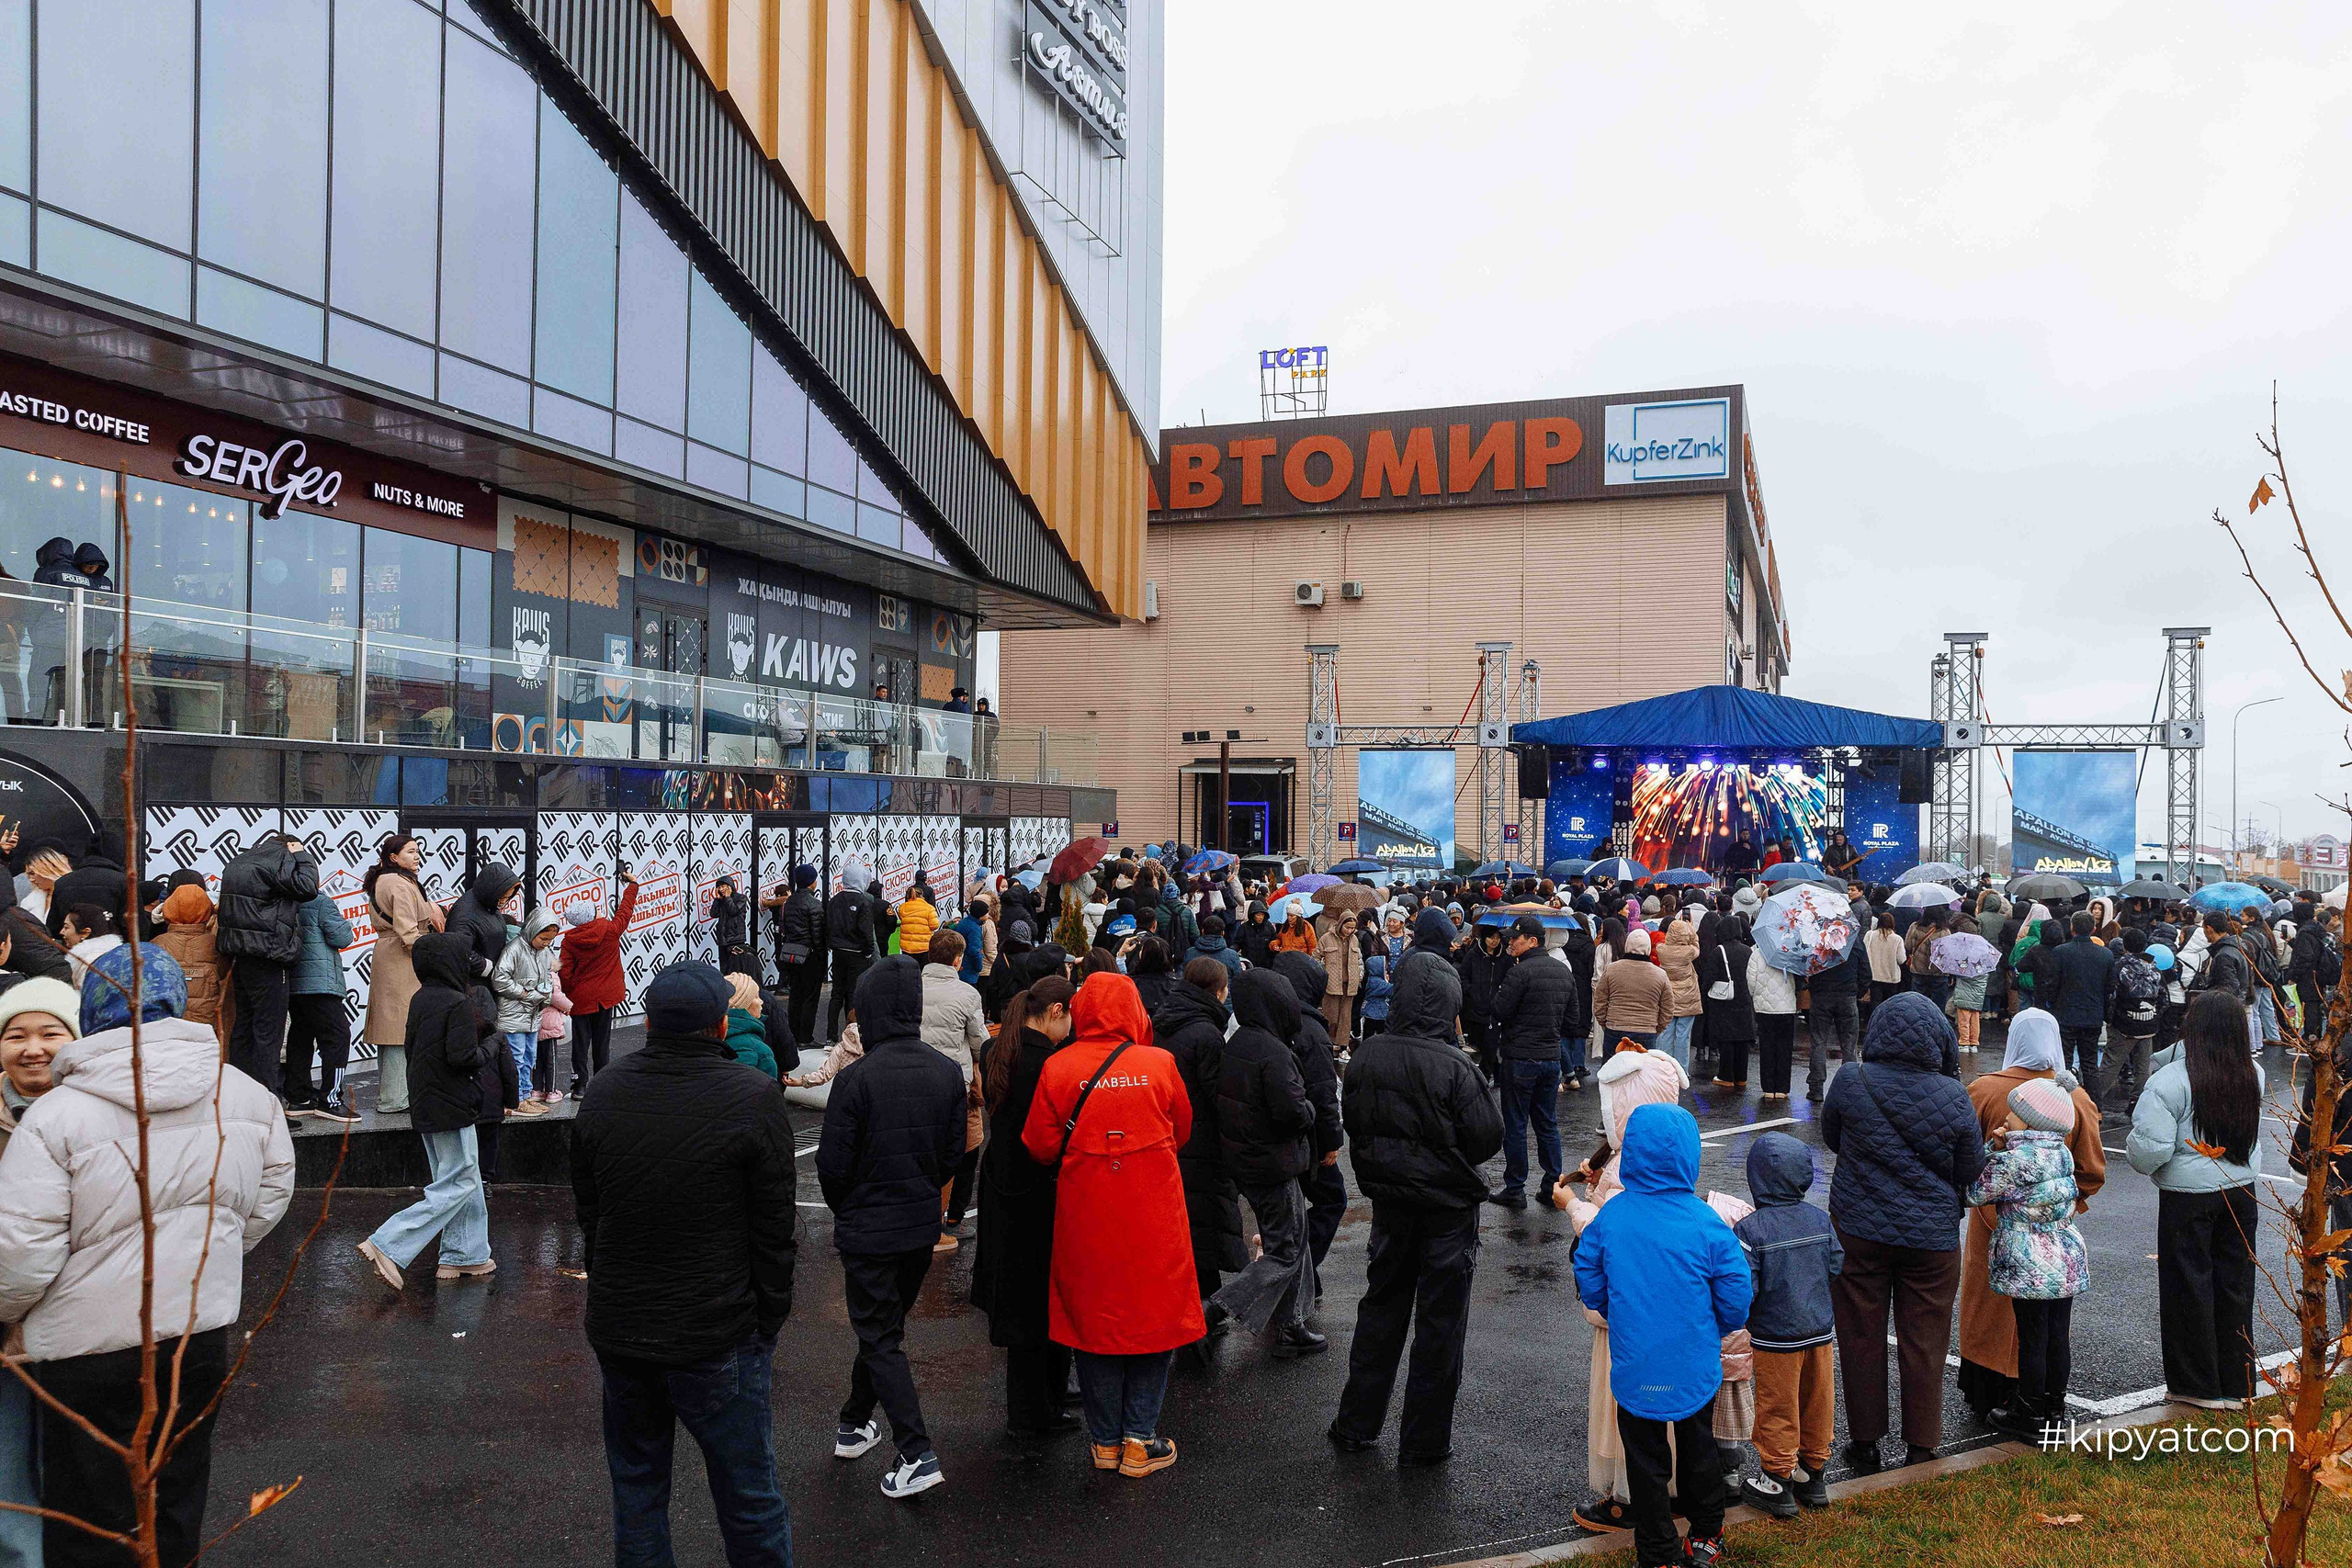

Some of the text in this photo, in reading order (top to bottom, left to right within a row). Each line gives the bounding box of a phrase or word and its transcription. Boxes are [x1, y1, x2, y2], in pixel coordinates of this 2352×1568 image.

[1261, 346, 1328, 369] LOFT
[1292, 369, 1328, 379] PARK
[74, 409, 150, 444] COFFEE
[374, 482, 464, 518] NUTS & MORE
[799, 592, 852, 618] АШЫЛУЫ
[762, 633, 858, 689] KAWS
[516, 675, 543, 690] COFFEE
[1360, 801, 1404, 827] APALLON
[2013, 808, 2071, 839] APALLON
[885, 870, 911, 891] СКОРО
